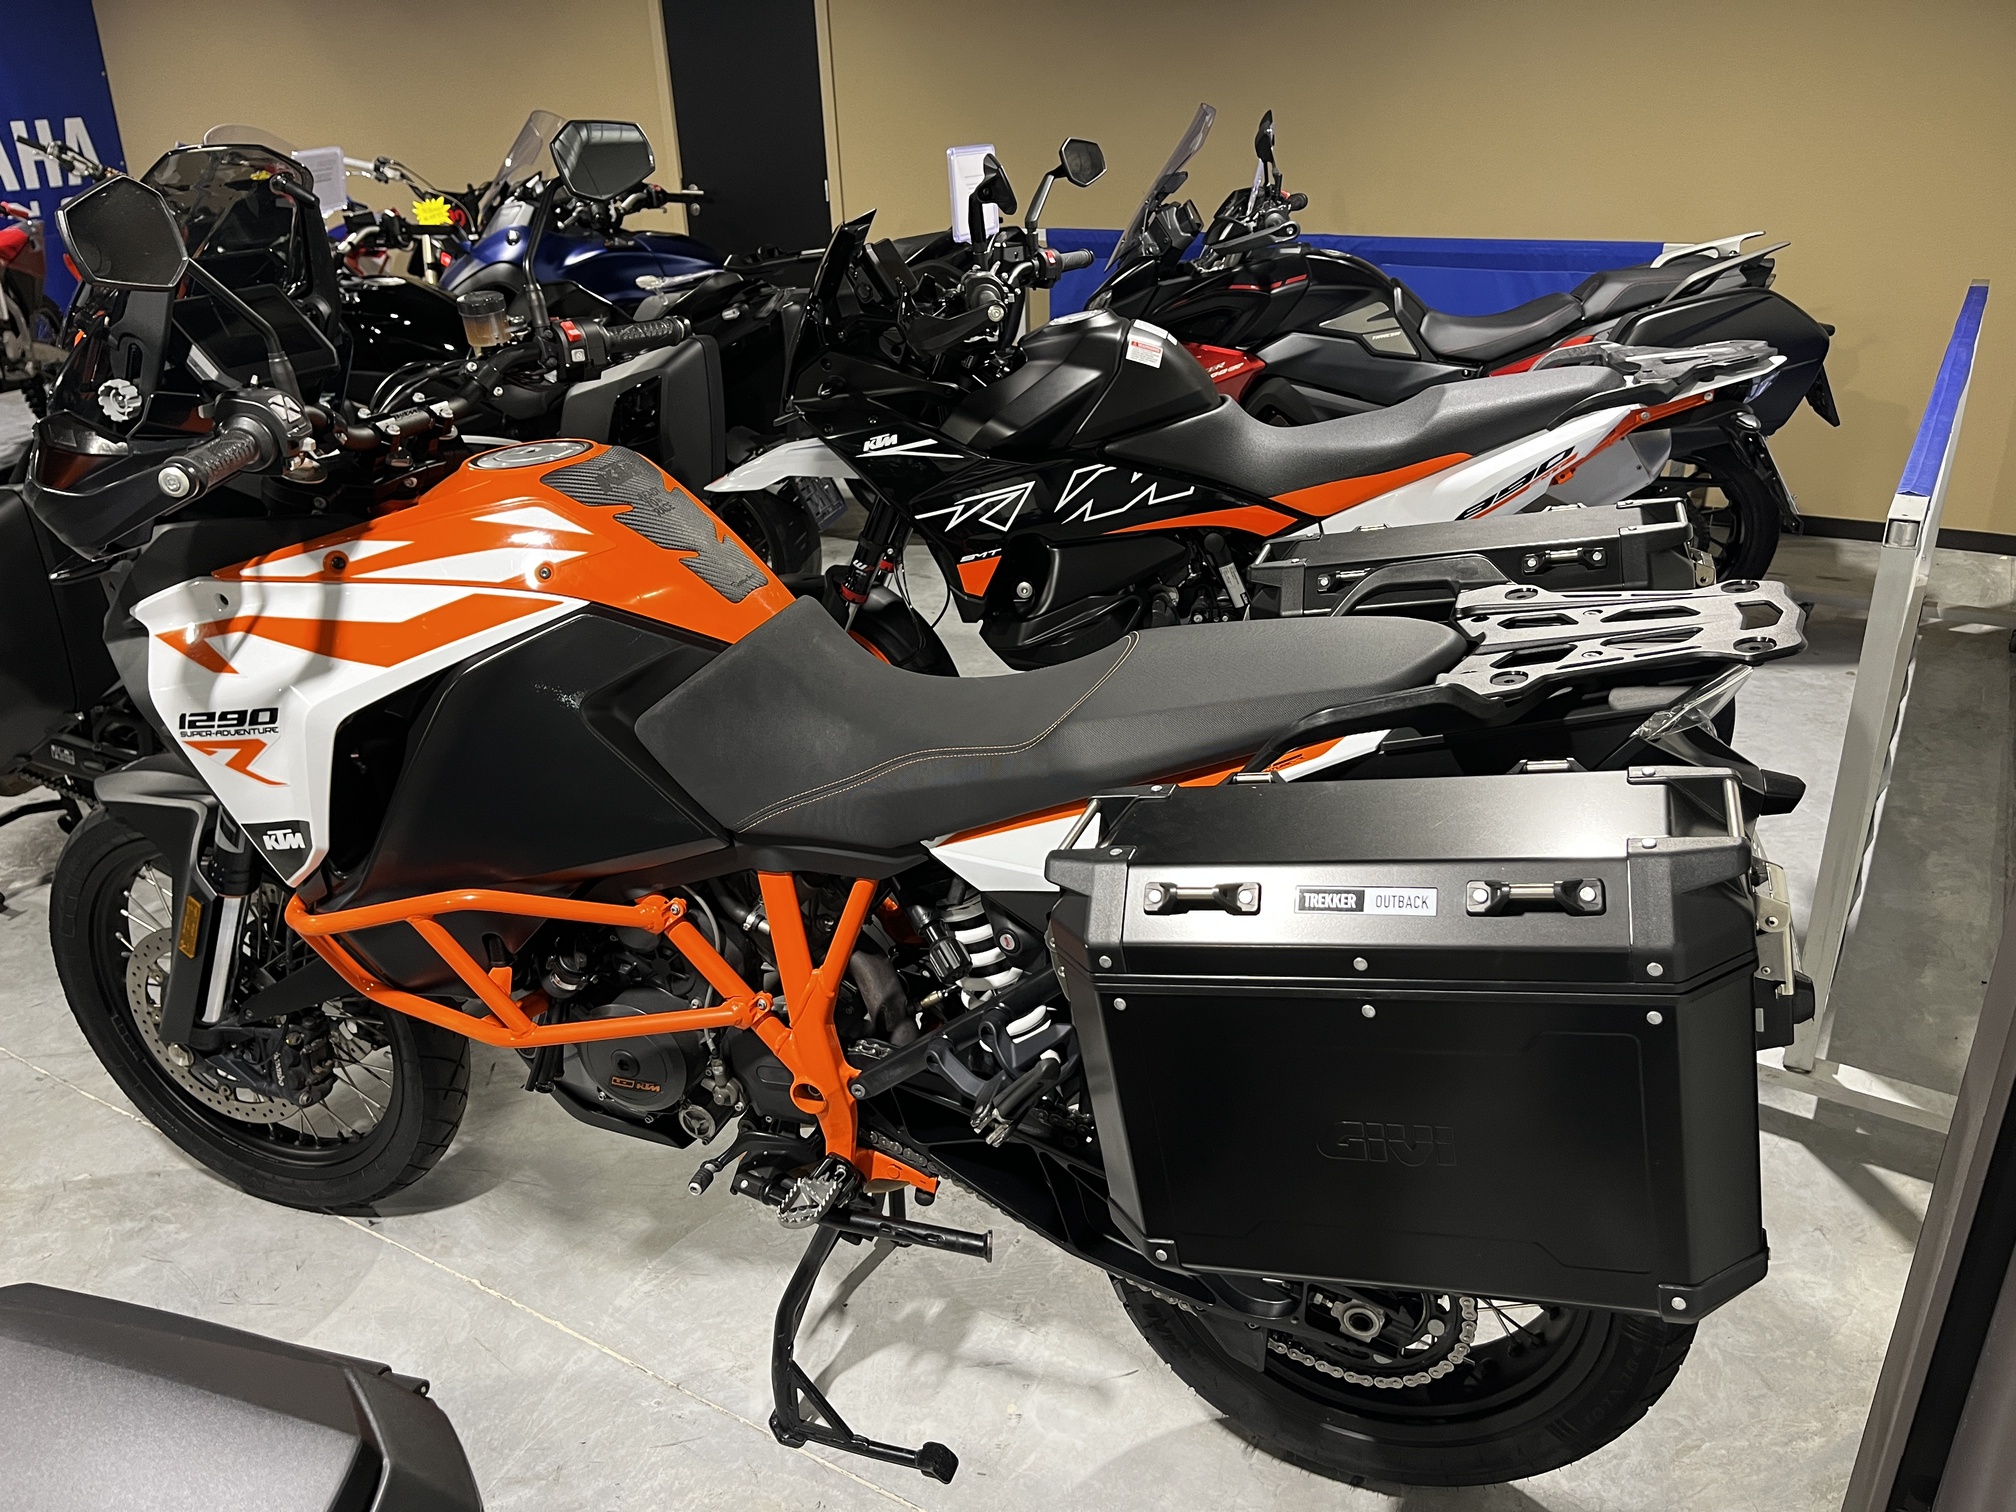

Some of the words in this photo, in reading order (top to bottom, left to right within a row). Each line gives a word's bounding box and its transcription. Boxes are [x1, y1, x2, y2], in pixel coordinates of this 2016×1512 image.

[863, 433, 897, 451] KTM
[179, 707, 279, 730] 1290
[180, 726, 279, 738] SUPER-ADVENTURE
[262, 828, 306, 851] KTM
[1303, 891, 1357, 909] TREKKER
[1375, 894, 1430, 910] OUTBACK
[636, 1082, 661, 1092] KTM
[1316, 1120, 1457, 1167] GIVI
